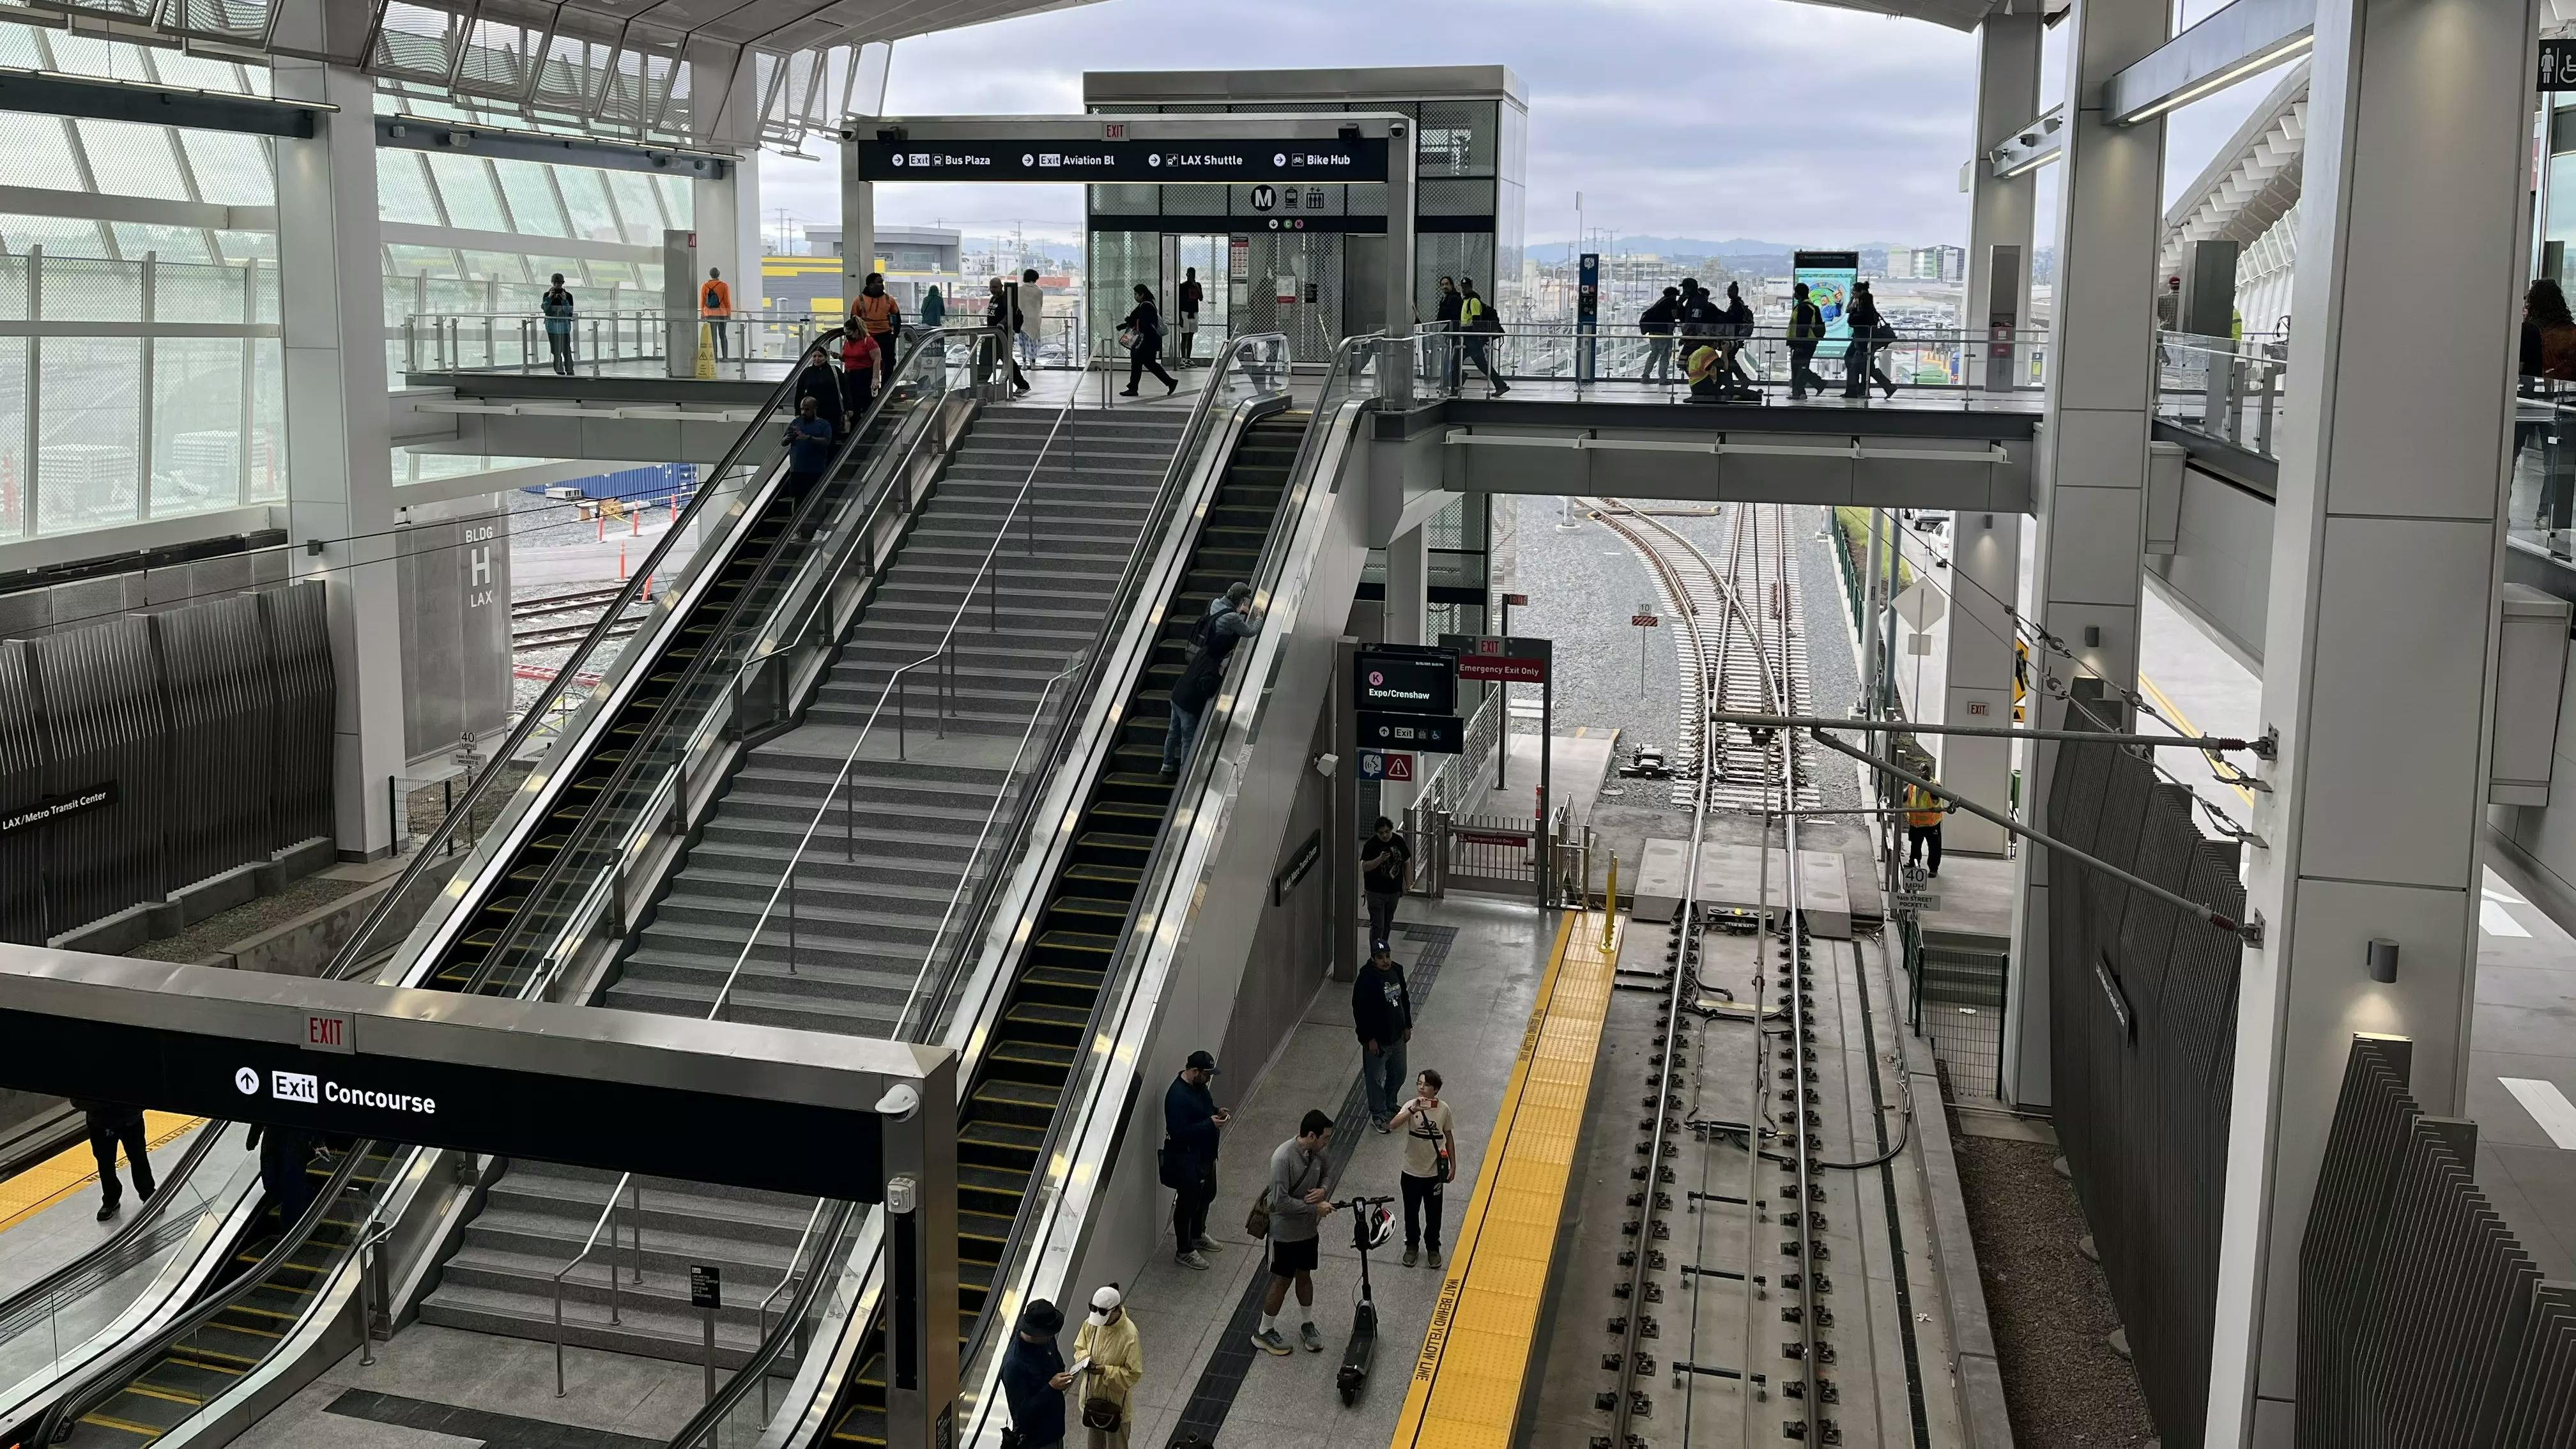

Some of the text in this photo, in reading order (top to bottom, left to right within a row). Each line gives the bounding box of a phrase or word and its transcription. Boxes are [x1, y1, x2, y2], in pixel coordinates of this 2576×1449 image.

[1107, 125, 1124, 137] EXIT
[911, 155, 990, 165] Exit Bus Plaza
[1041, 155, 1114, 165] Exit Aviation Bl
[1181, 155, 1243, 165] LAX Shuttle
[1307, 155, 1350, 165] Bike Hub
[1255, 189, 1272, 207] M
[465, 526, 493, 544] BLDG
[471, 546, 491, 586] H
[471, 590, 493, 608] LAX
[1481, 641, 1499, 653] EXIT
[1459, 664, 1539, 677] Emergency Exit Only
[1368, 689, 1430, 700] Expo/Crenshaw
[1971, 705, 1986, 715] EXIT
[461, 732, 475, 742] 40
[1397, 729, 1412, 737] Exit
[3, 792, 106, 830] LAX/Metro Transit Center
[1905, 870, 1924, 882] 40
[310, 1016, 343, 1046] EXIT
[1518, 1008, 1544, 1062] WAIT BEHIND YELLOW LINE
[276, 1075, 436, 1114] Exit Concourse
[152, 1126, 192, 1149] YELLOW
[1415, 1278, 1460, 1382] WAIT BEHIND YELLOW LINE
